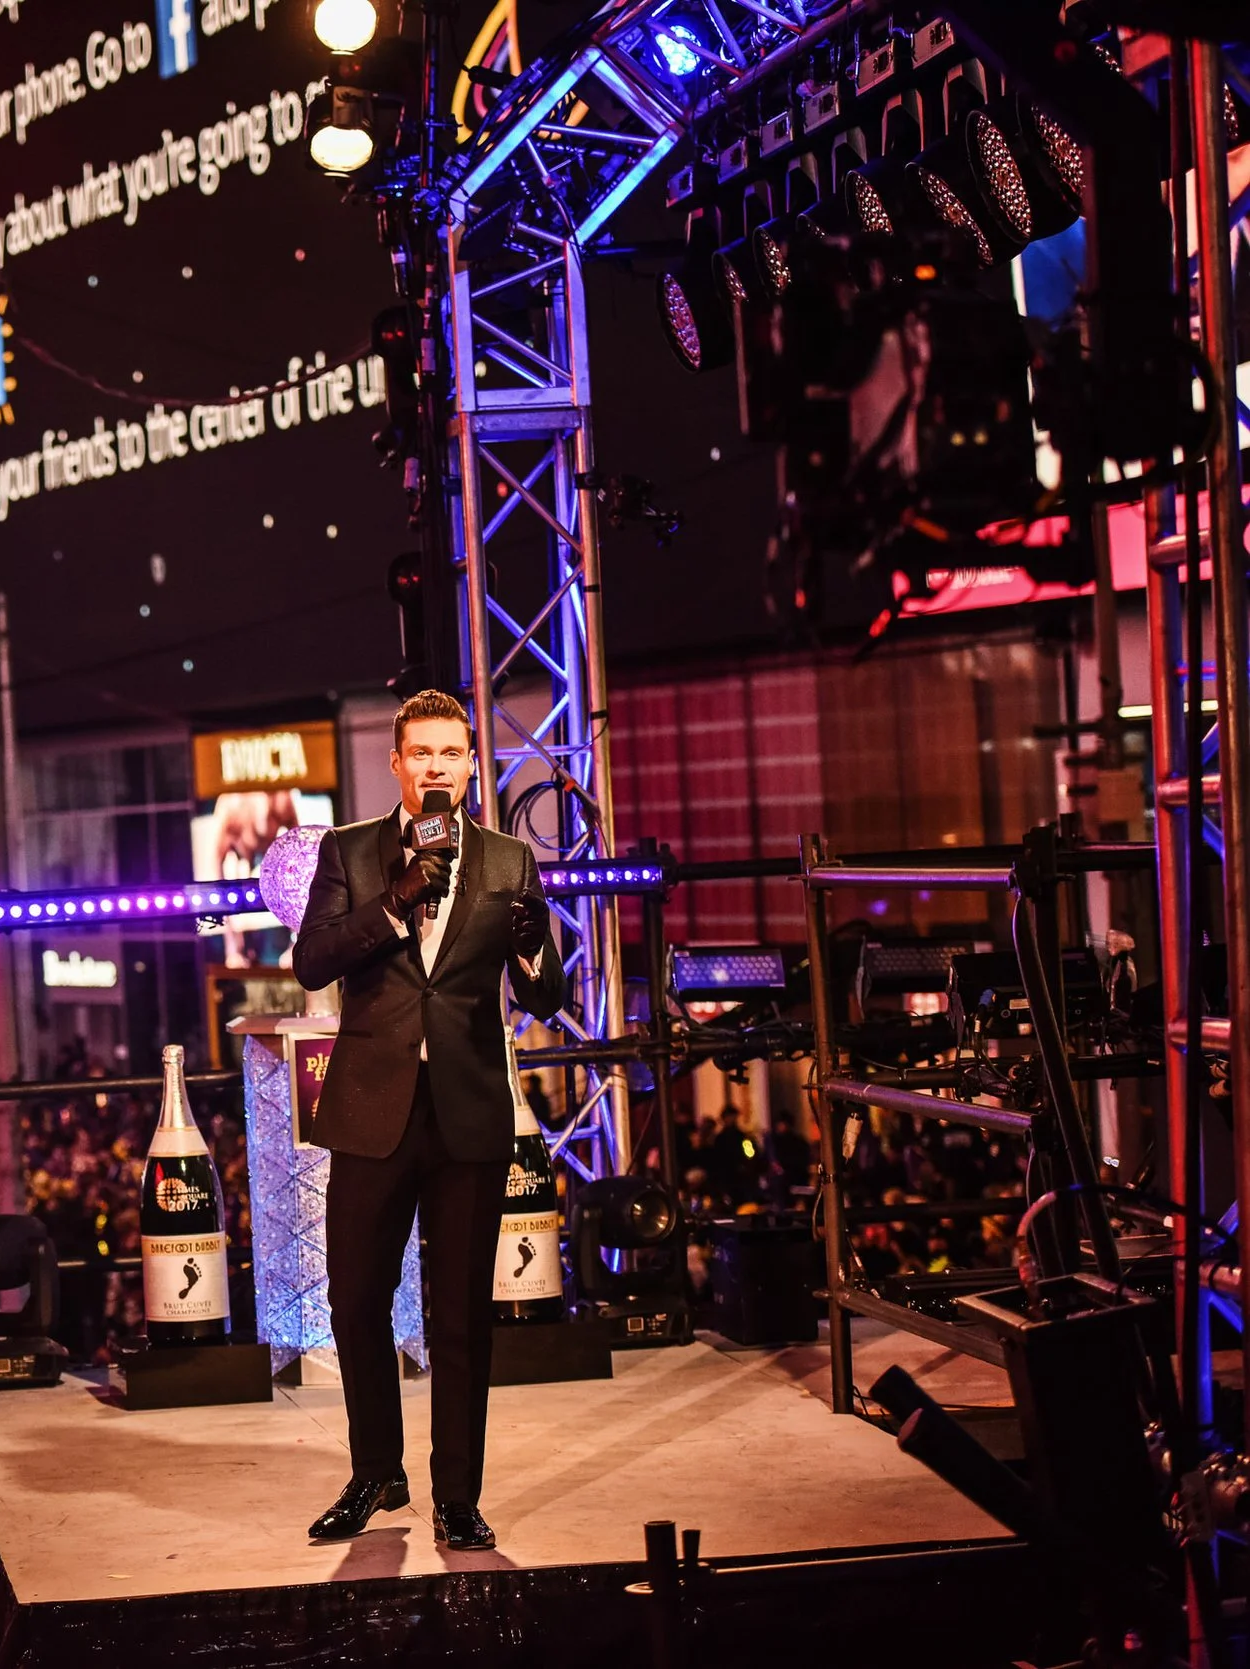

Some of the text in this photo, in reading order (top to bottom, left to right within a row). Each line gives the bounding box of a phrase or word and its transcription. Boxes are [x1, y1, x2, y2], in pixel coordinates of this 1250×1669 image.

[86, 31, 122, 90] Go
[123, 21, 152, 74] to
[5, 185, 68, 256] about
[66, 160, 124, 229] what
[123, 129, 197, 226] you're
[198, 101, 271, 195] going
[270, 89, 303, 146] to
[42, 416, 117, 491] friends
[117, 419, 145, 472] to
[146, 403, 188, 464] the
